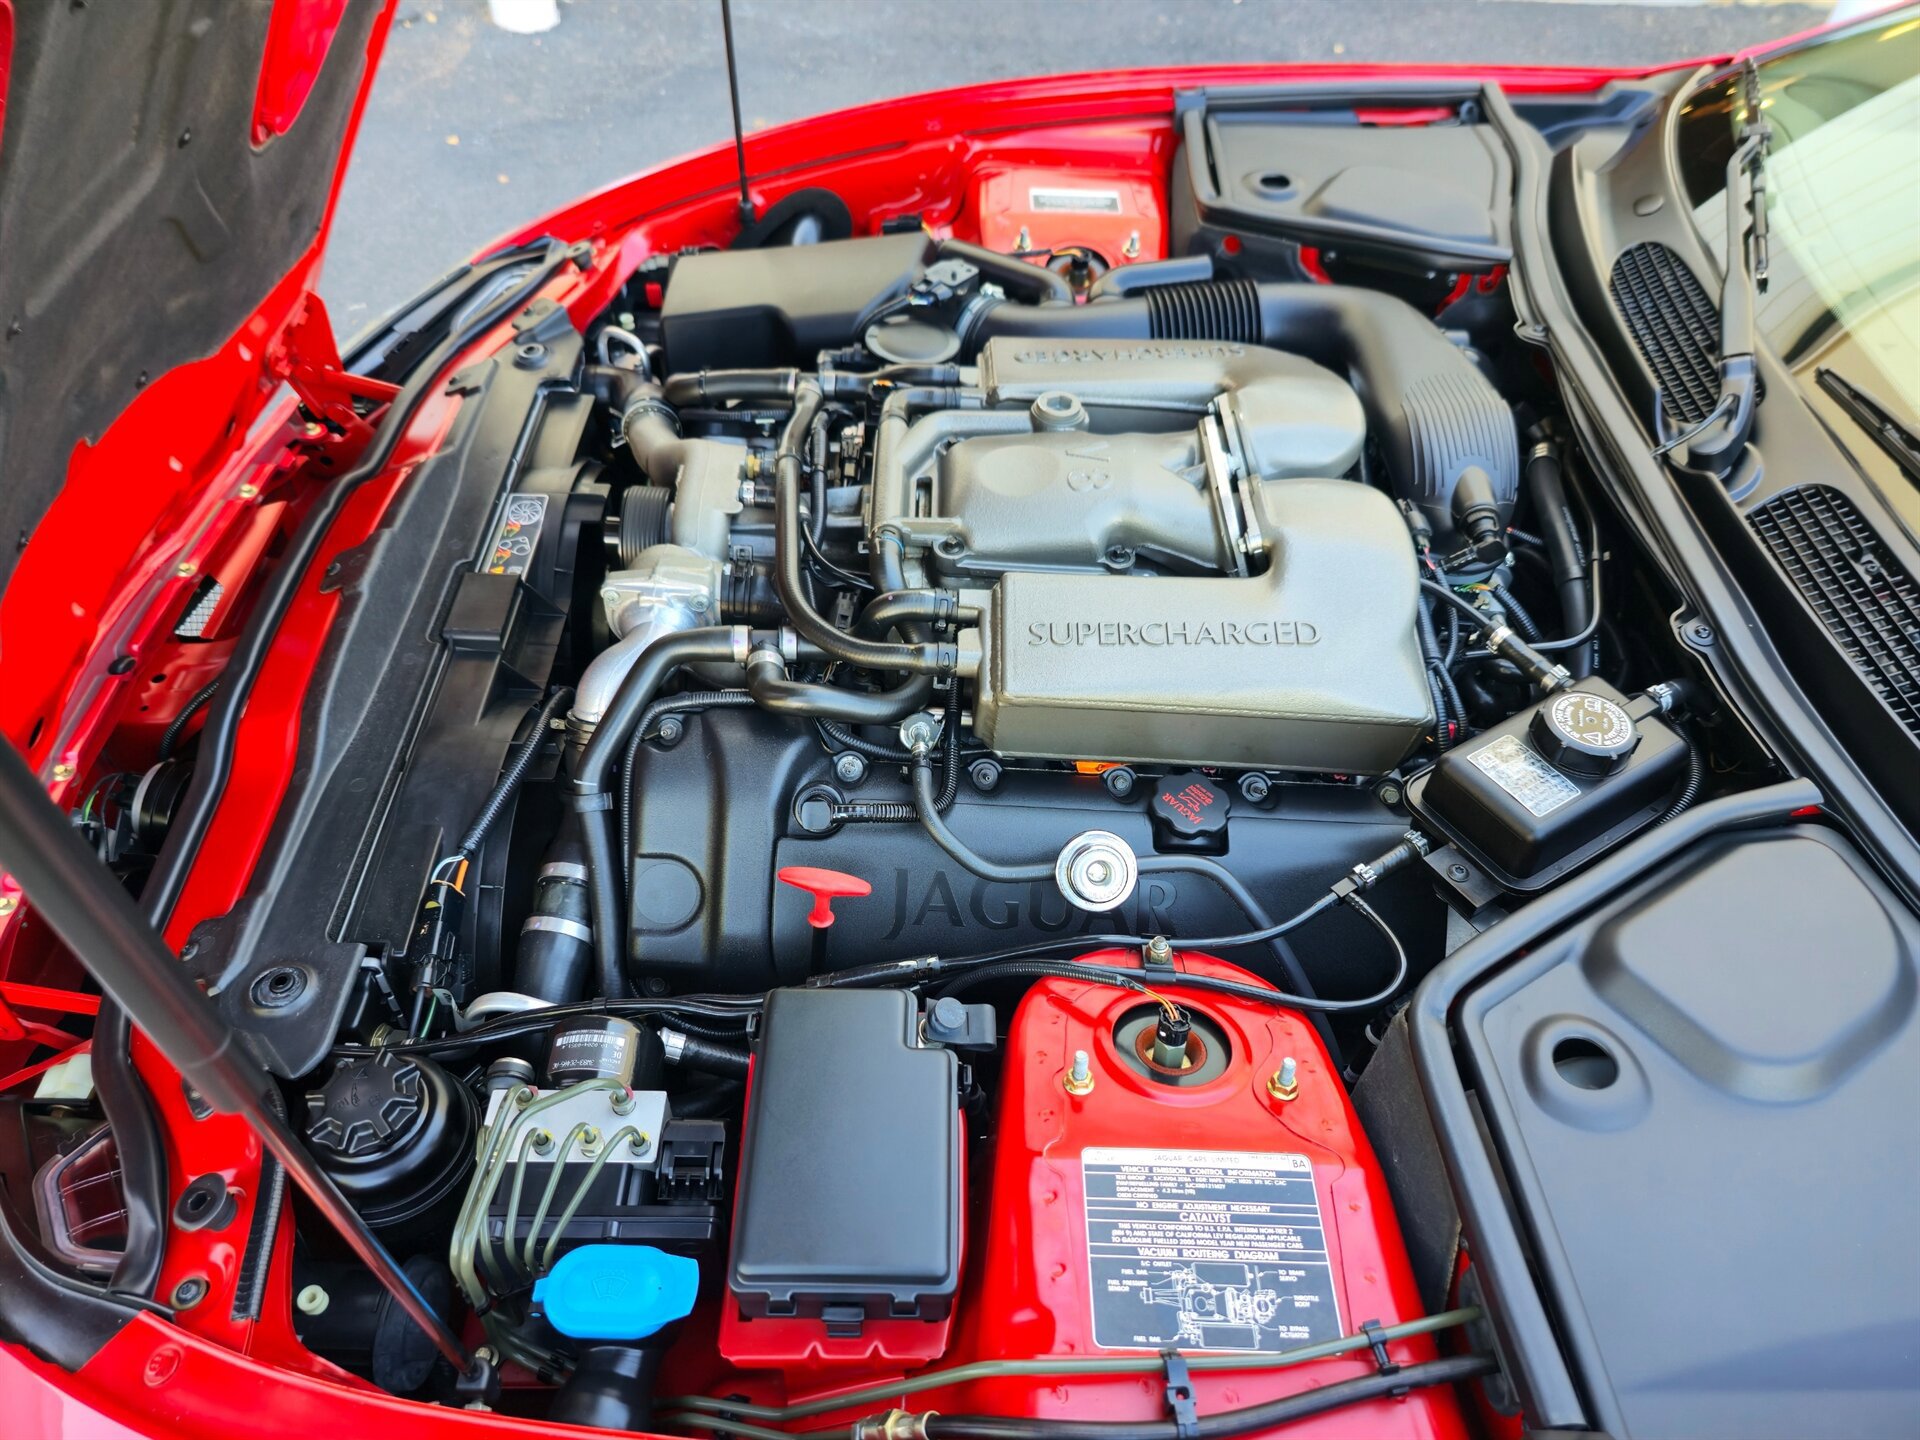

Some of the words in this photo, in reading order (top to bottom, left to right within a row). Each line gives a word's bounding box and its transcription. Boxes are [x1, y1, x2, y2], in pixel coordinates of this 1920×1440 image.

[1028, 621, 1321, 646] SUPERCHARGED
[1162, 793, 1204, 824] JAGUAR
[1292, 1159, 1306, 1168] BA
[1152, 1166, 1186, 1174] EMISSION
[1189, 1168, 1224, 1176] CONTROL
[1227, 1169, 1276, 1178] INFORMATION
[1182, 1203, 1227, 1211] ADJUSTMENT
[1180, 1213, 1231, 1223] CATALYST
[1224, 1233, 1266, 1241] REGULATIONS
[1137, 1247, 1178, 1257] VACUUM
[1182, 1248, 1230, 1259] ROUTEING
[1234, 1250, 1279, 1260] DIAGRAM
